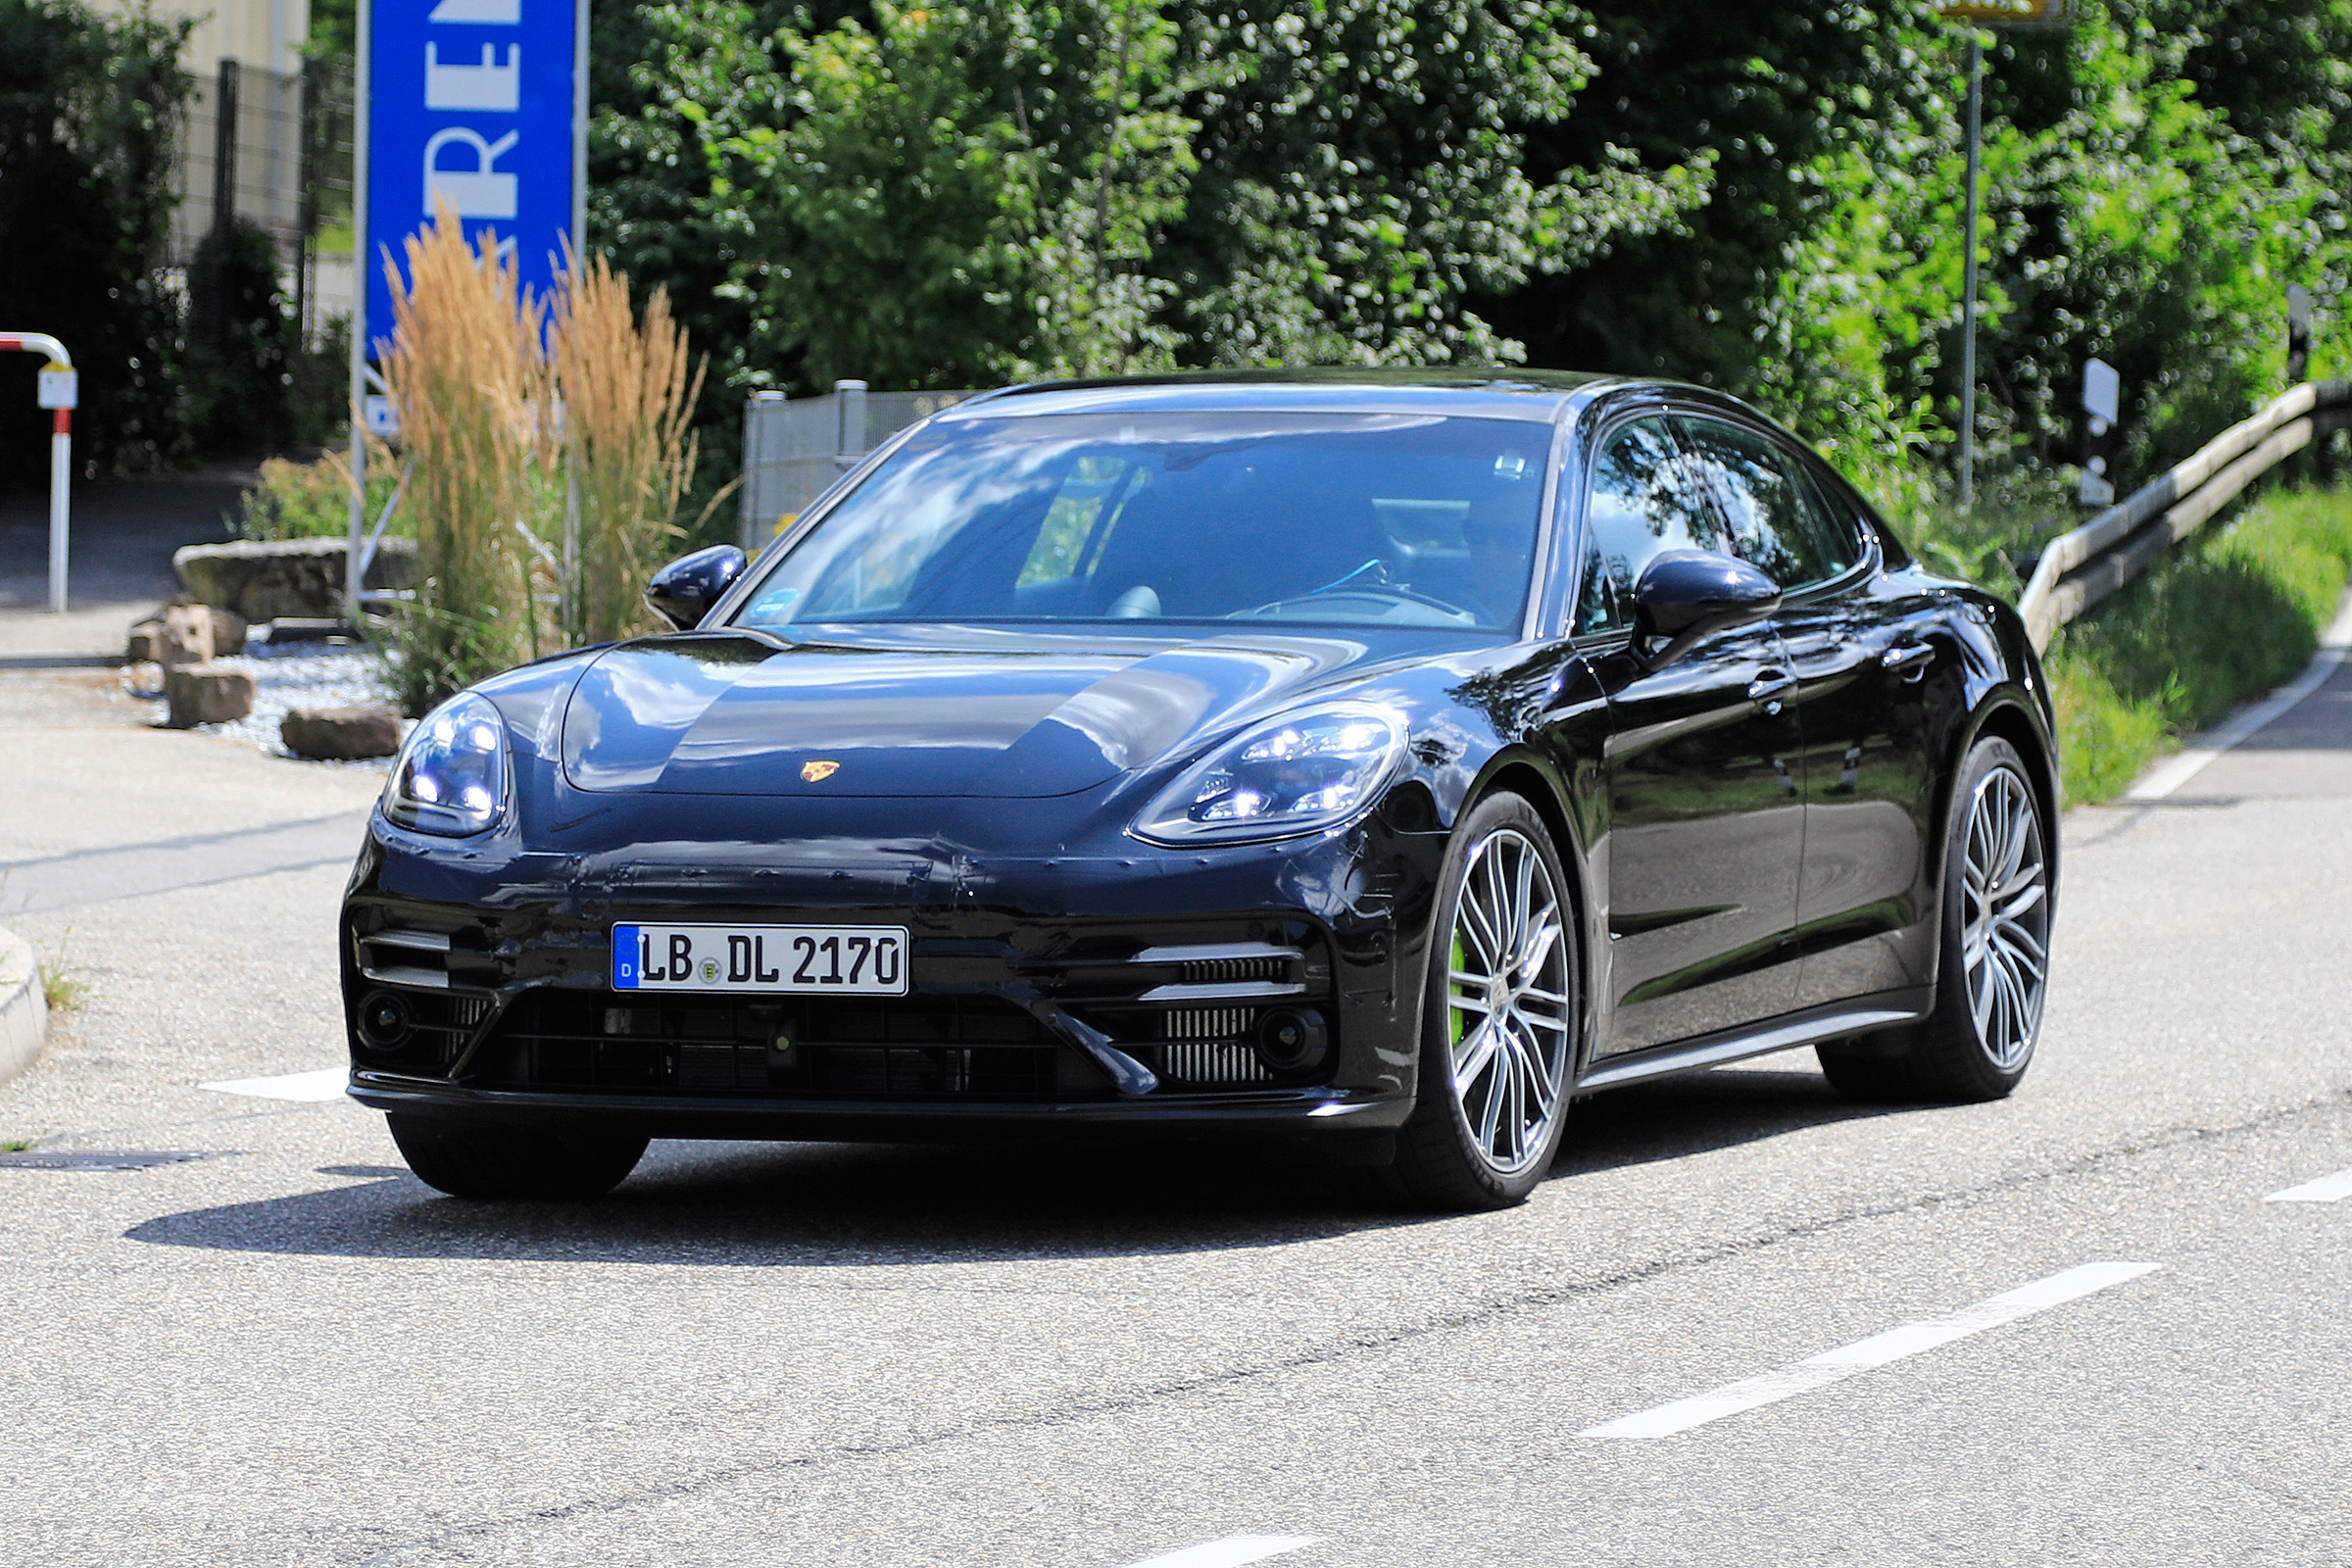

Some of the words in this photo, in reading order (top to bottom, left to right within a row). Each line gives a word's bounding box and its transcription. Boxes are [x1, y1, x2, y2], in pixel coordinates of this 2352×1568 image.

[621, 963, 632, 977] D
[642, 933, 692, 981] LB
[727, 935, 779, 983] DL
[793, 936, 899, 984] 2170
